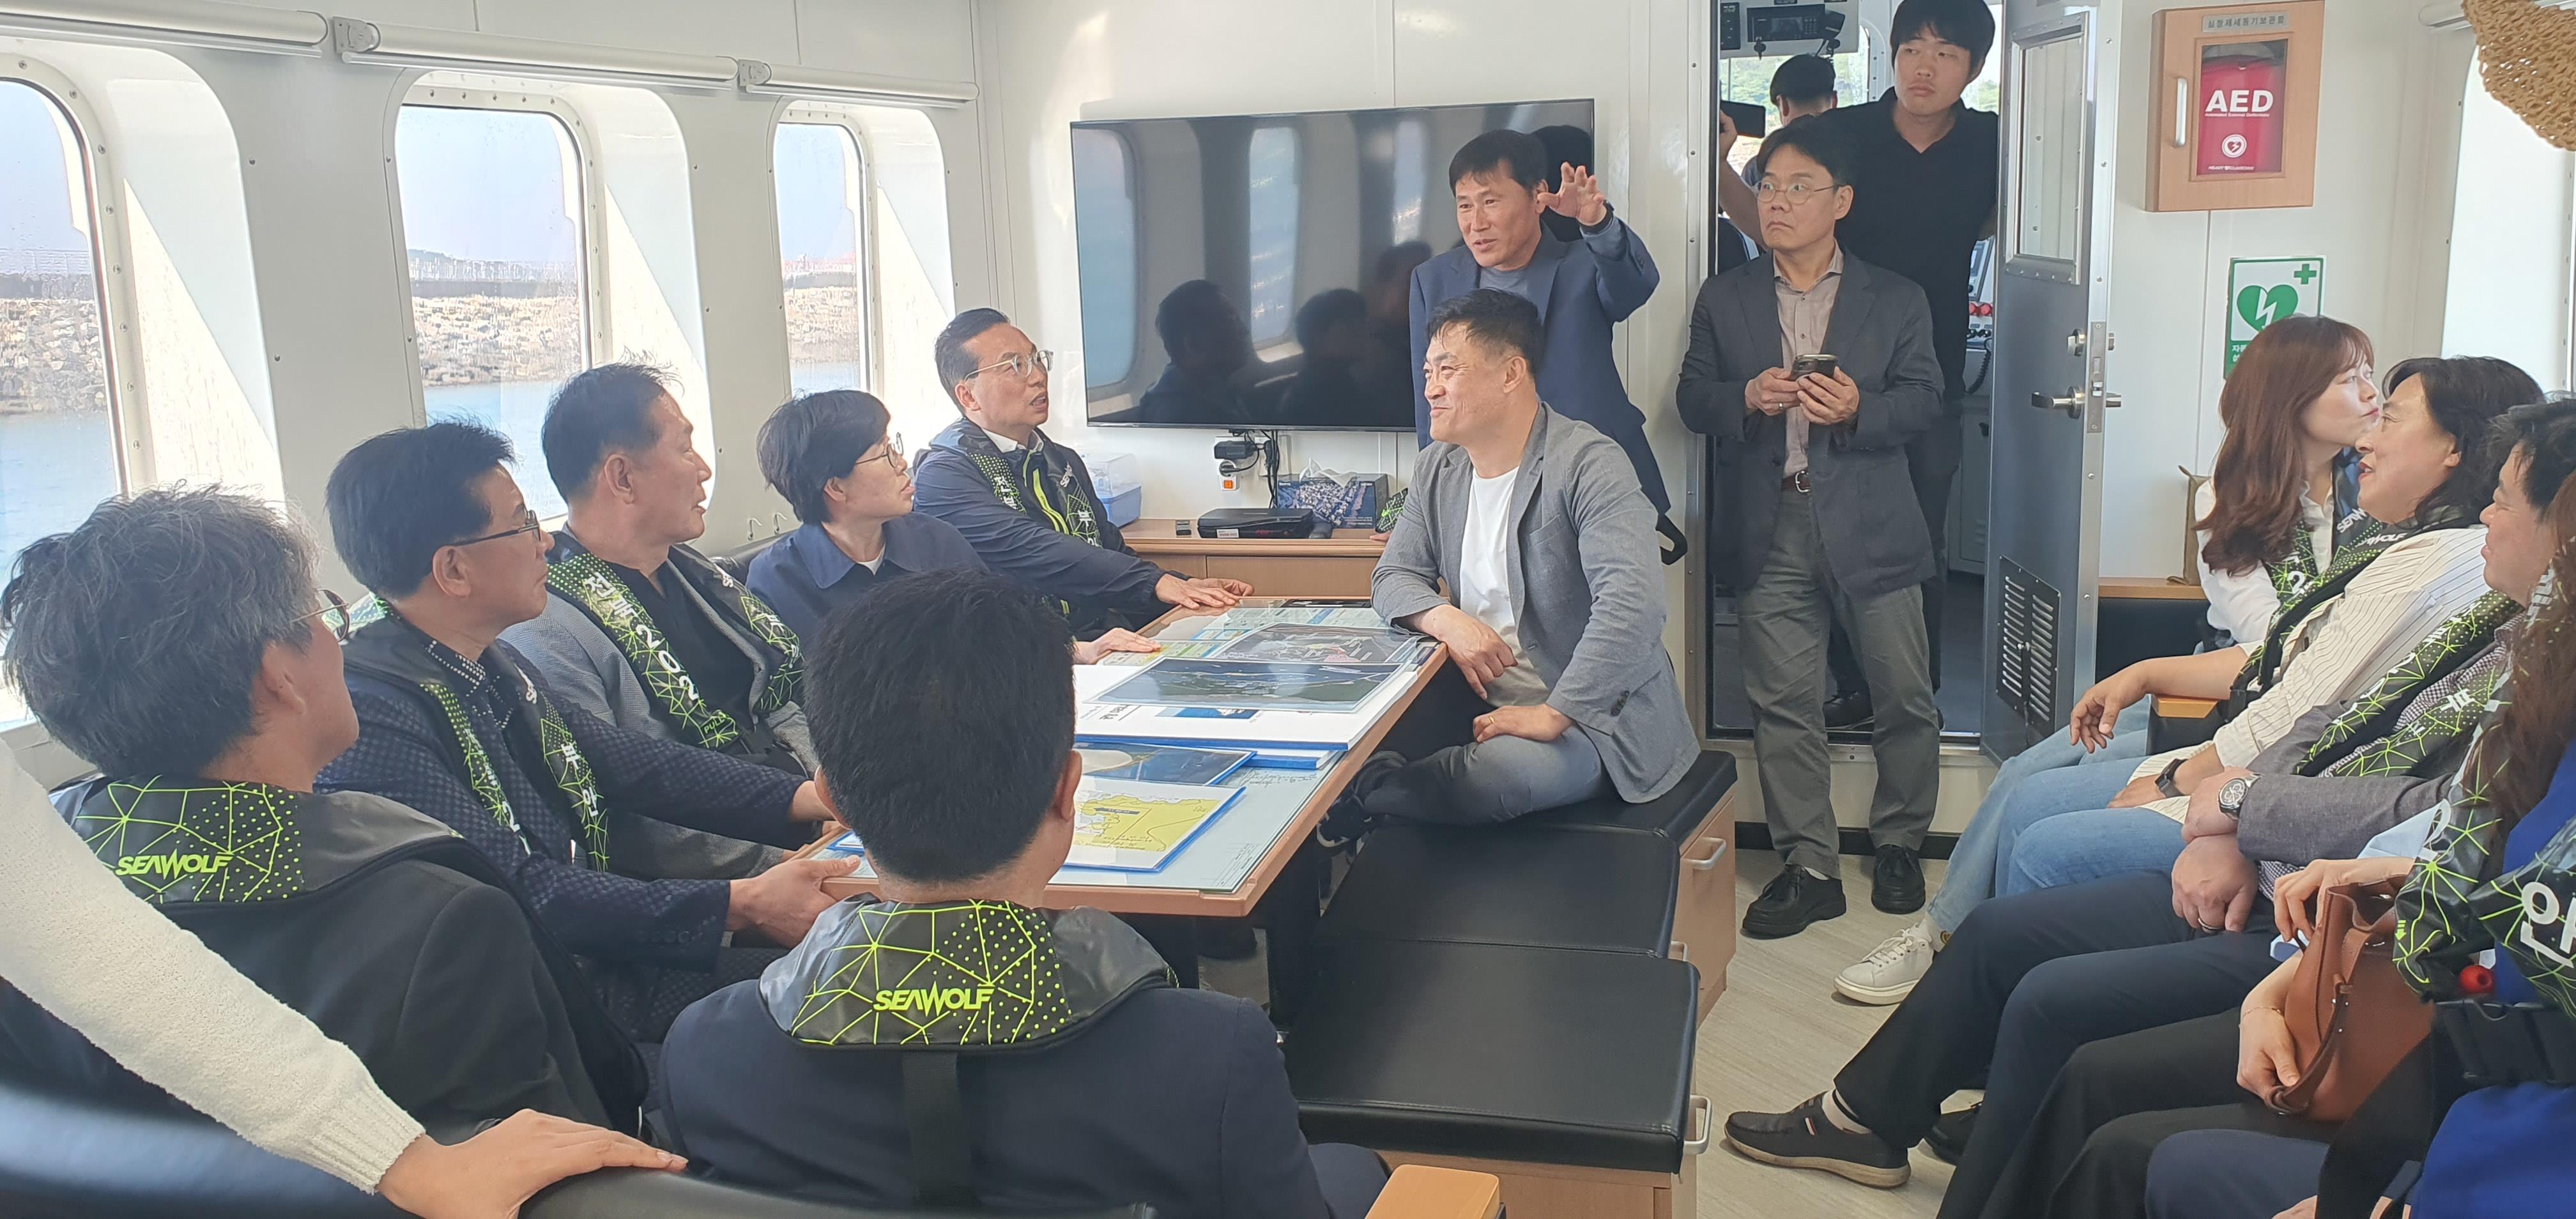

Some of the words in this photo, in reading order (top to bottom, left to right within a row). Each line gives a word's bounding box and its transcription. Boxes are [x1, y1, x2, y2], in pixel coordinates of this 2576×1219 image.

[2204, 89, 2274, 112] AED
[2336, 507, 2368, 533] SEAW
[703, 715, 726, 734] PULL
[115, 848, 233, 880] SEAWOLF
[873, 981, 995, 1017] SEAWOLF
